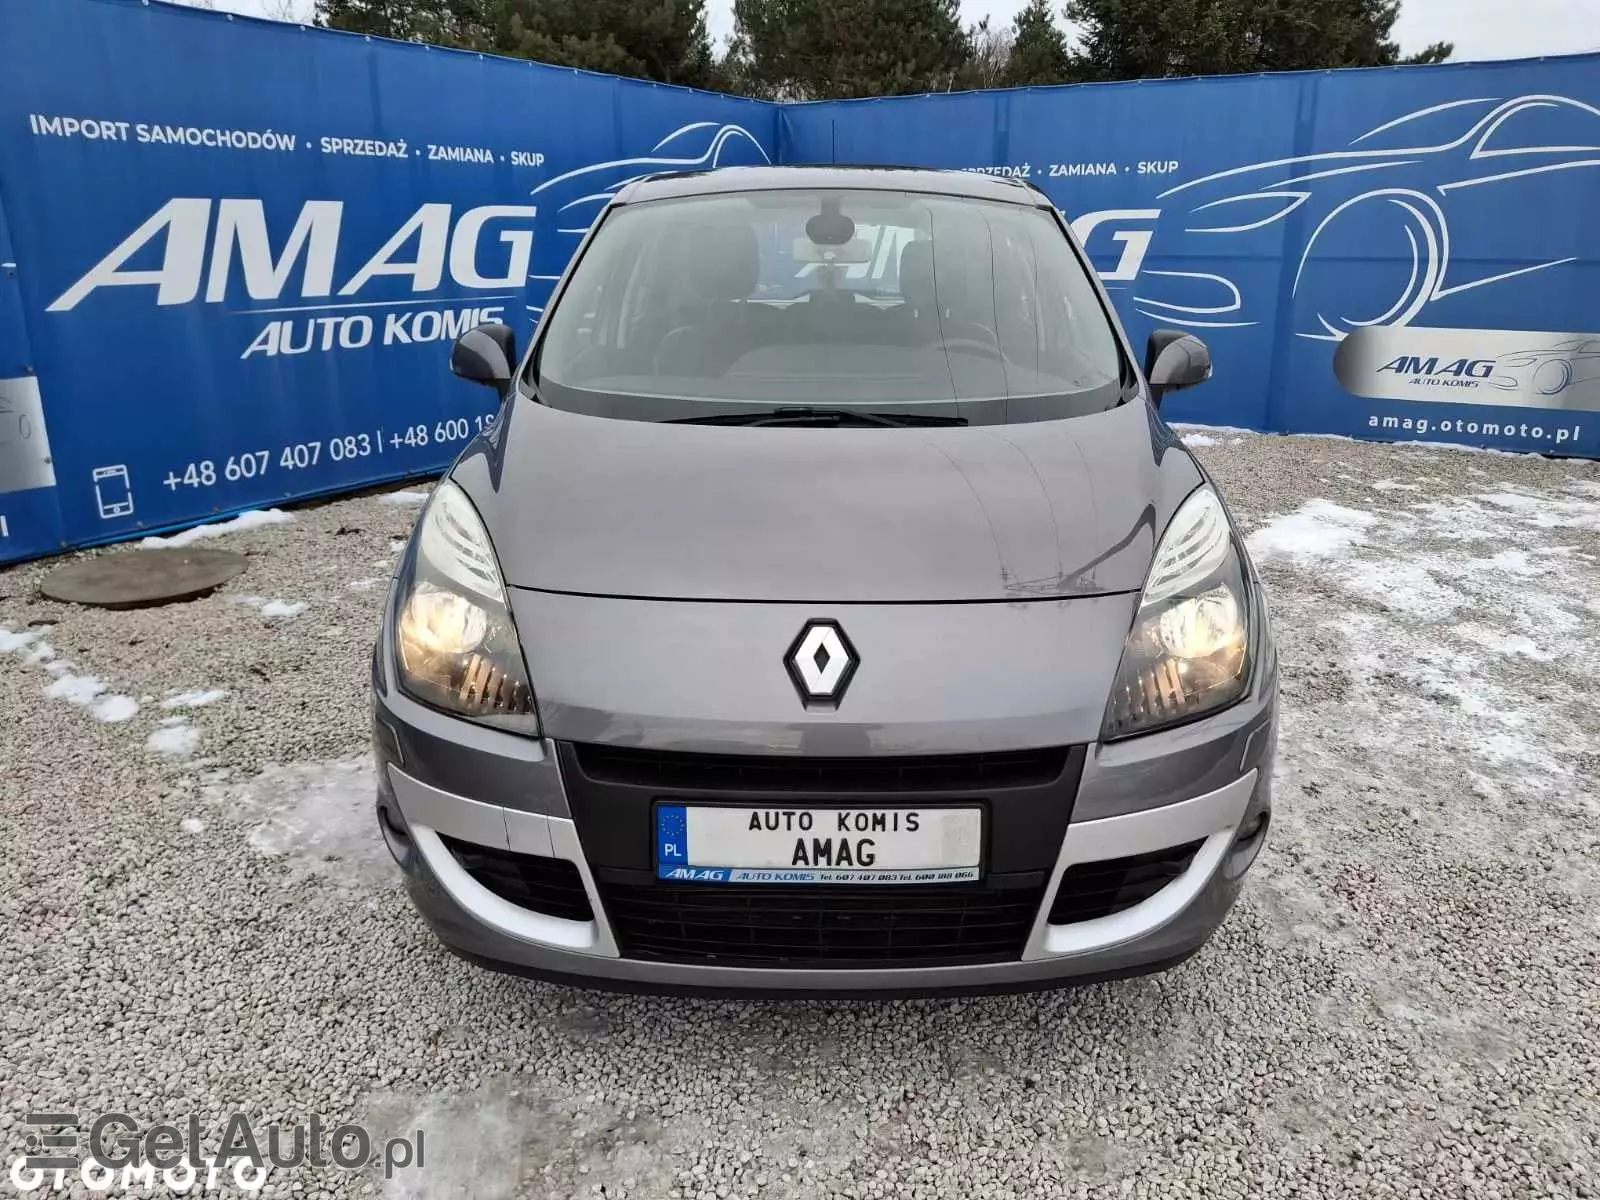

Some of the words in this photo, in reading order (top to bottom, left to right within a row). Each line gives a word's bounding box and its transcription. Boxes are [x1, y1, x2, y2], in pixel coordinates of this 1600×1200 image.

[30, 113, 130, 142] IMPORT
[136, 122, 297, 152] SAMOCHODÓW
[320, 136, 409, 159] SPRZEDAŻ
[427, 144, 495, 165] ZAMIANA
[511, 151, 545, 168] SKUP
[1048, 162, 1117, 178] ZAMIANA
[1137, 160, 1179, 176] SKUP
[240, 315, 373, 359] AUTO
[1376, 355, 1497, 379] AMAG
[1408, 378, 1440, 386] AUTO
[1442, 379, 1480, 389] KOMIS
[1368, 413, 1580, 443] amag.otomoto.pl
[163, 461, 217, 492] +48
[225, 451, 269, 481] 607
[280, 441, 321, 470] 407
[330, 433, 371, 461] 083
[389, 424, 429, 449] +48
[434, 418, 469, 442] 600
[749, 811, 813, 832] AUTO
[837, 811, 920, 832] KOMIS
[664, 843, 682, 857] PL
[791, 838, 876, 867] AMAG
[665, 868, 725, 881] AMAG
[737, 871, 771, 881] AUTO
[775, 871, 815, 881] KOMIS
